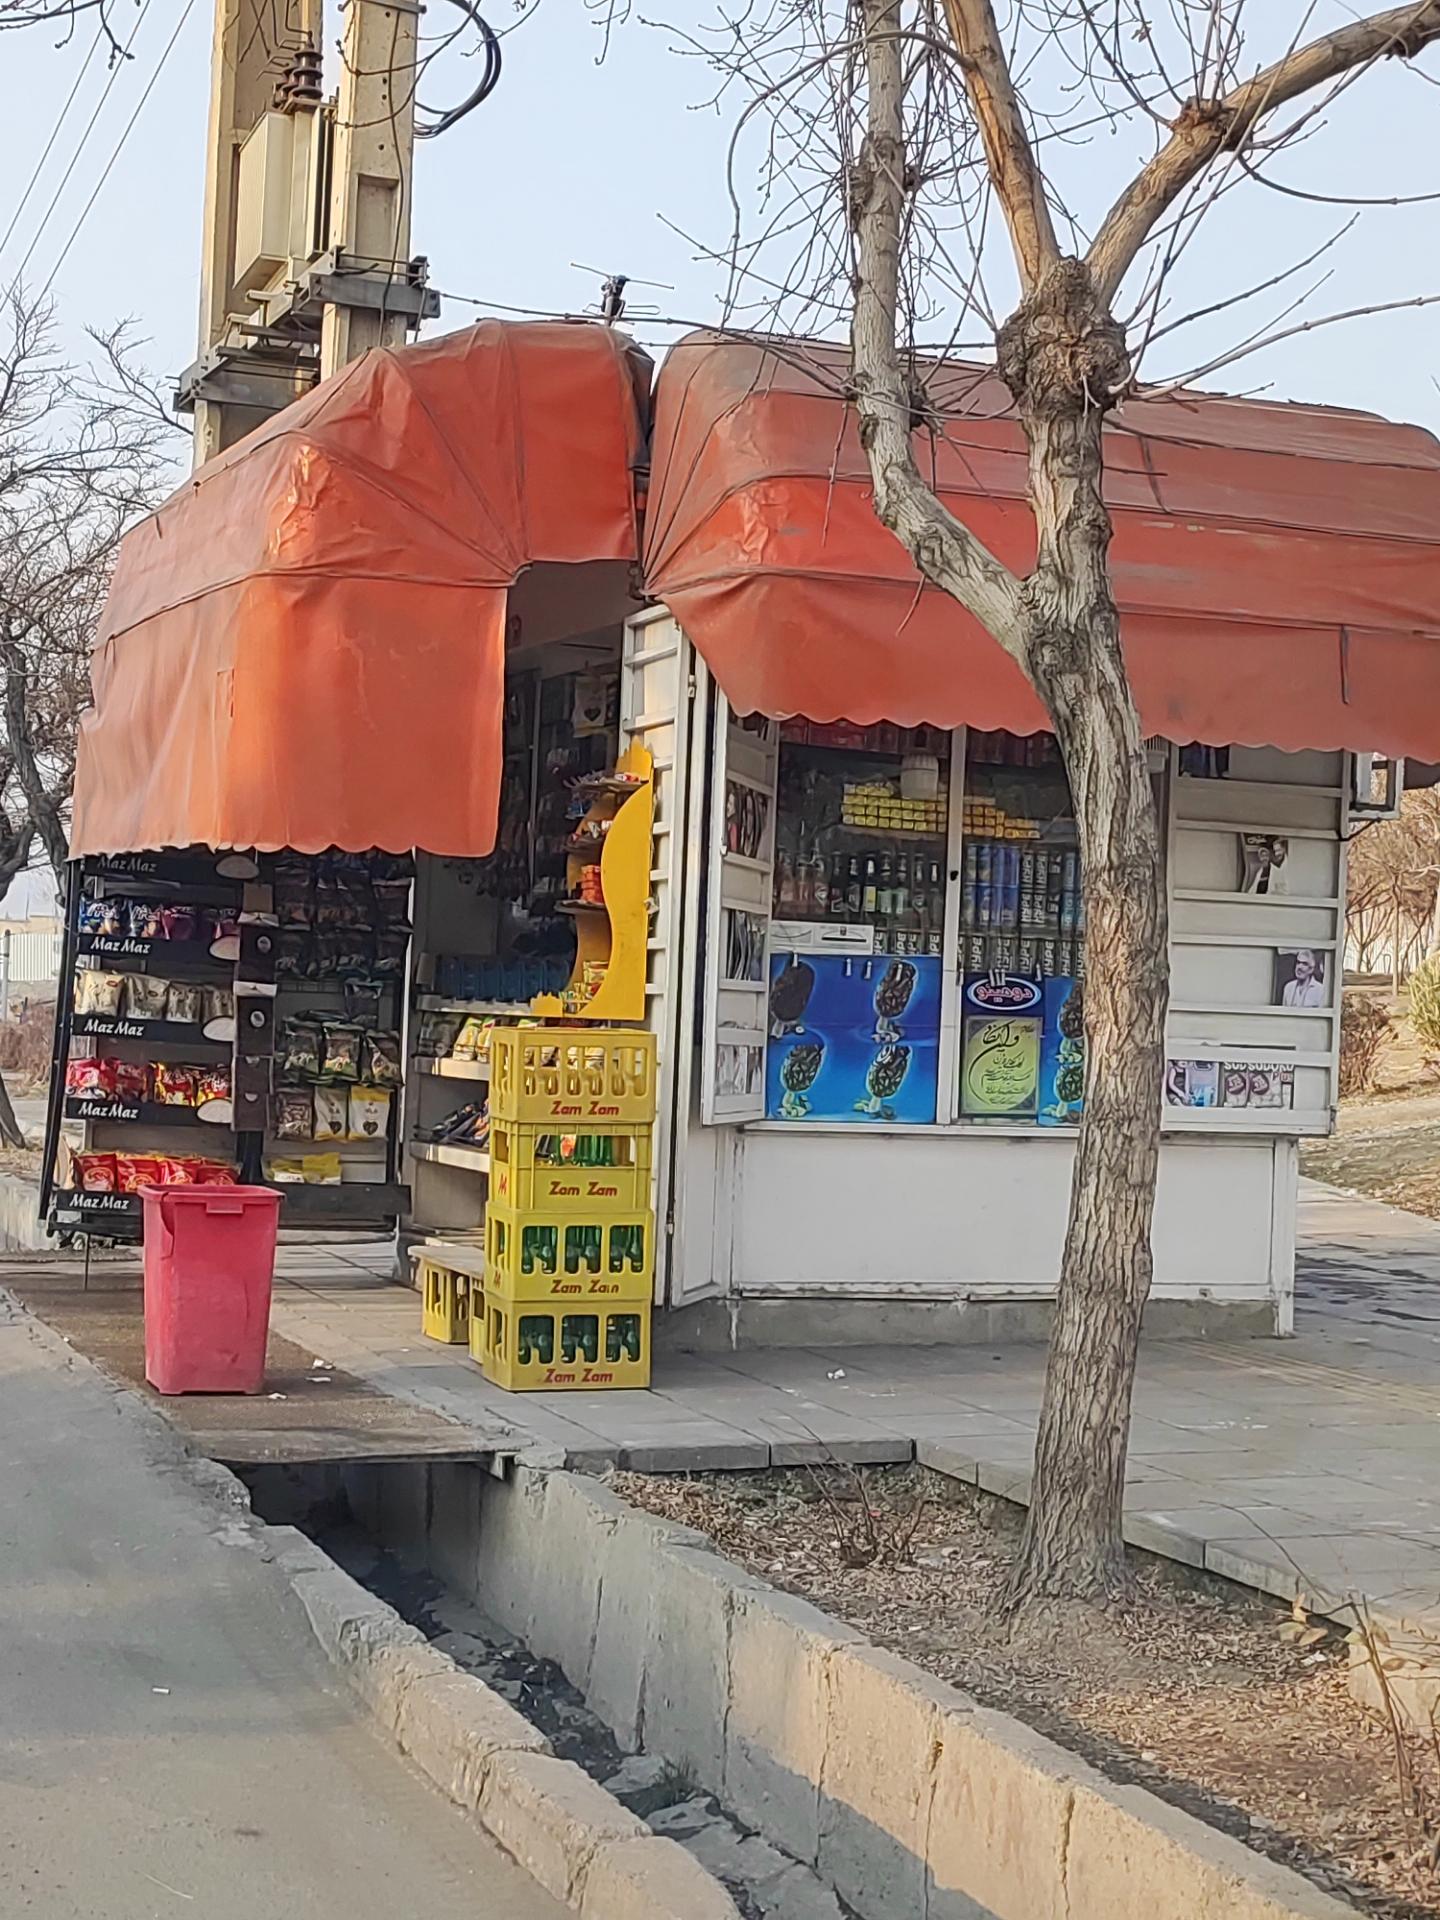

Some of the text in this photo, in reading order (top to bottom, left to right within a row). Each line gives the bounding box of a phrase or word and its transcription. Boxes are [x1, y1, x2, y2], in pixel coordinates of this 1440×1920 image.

[971, 937, 983, 971] HYPE
[1044, 940, 1055, 977] HYPE
[550, 1100, 620, 1116] Zam Zam
[549, 1181, 618, 1197] Zam Zam
[550, 1279, 583, 1294] Zam
[544, 1368, 613, 1384] Zam Zam
